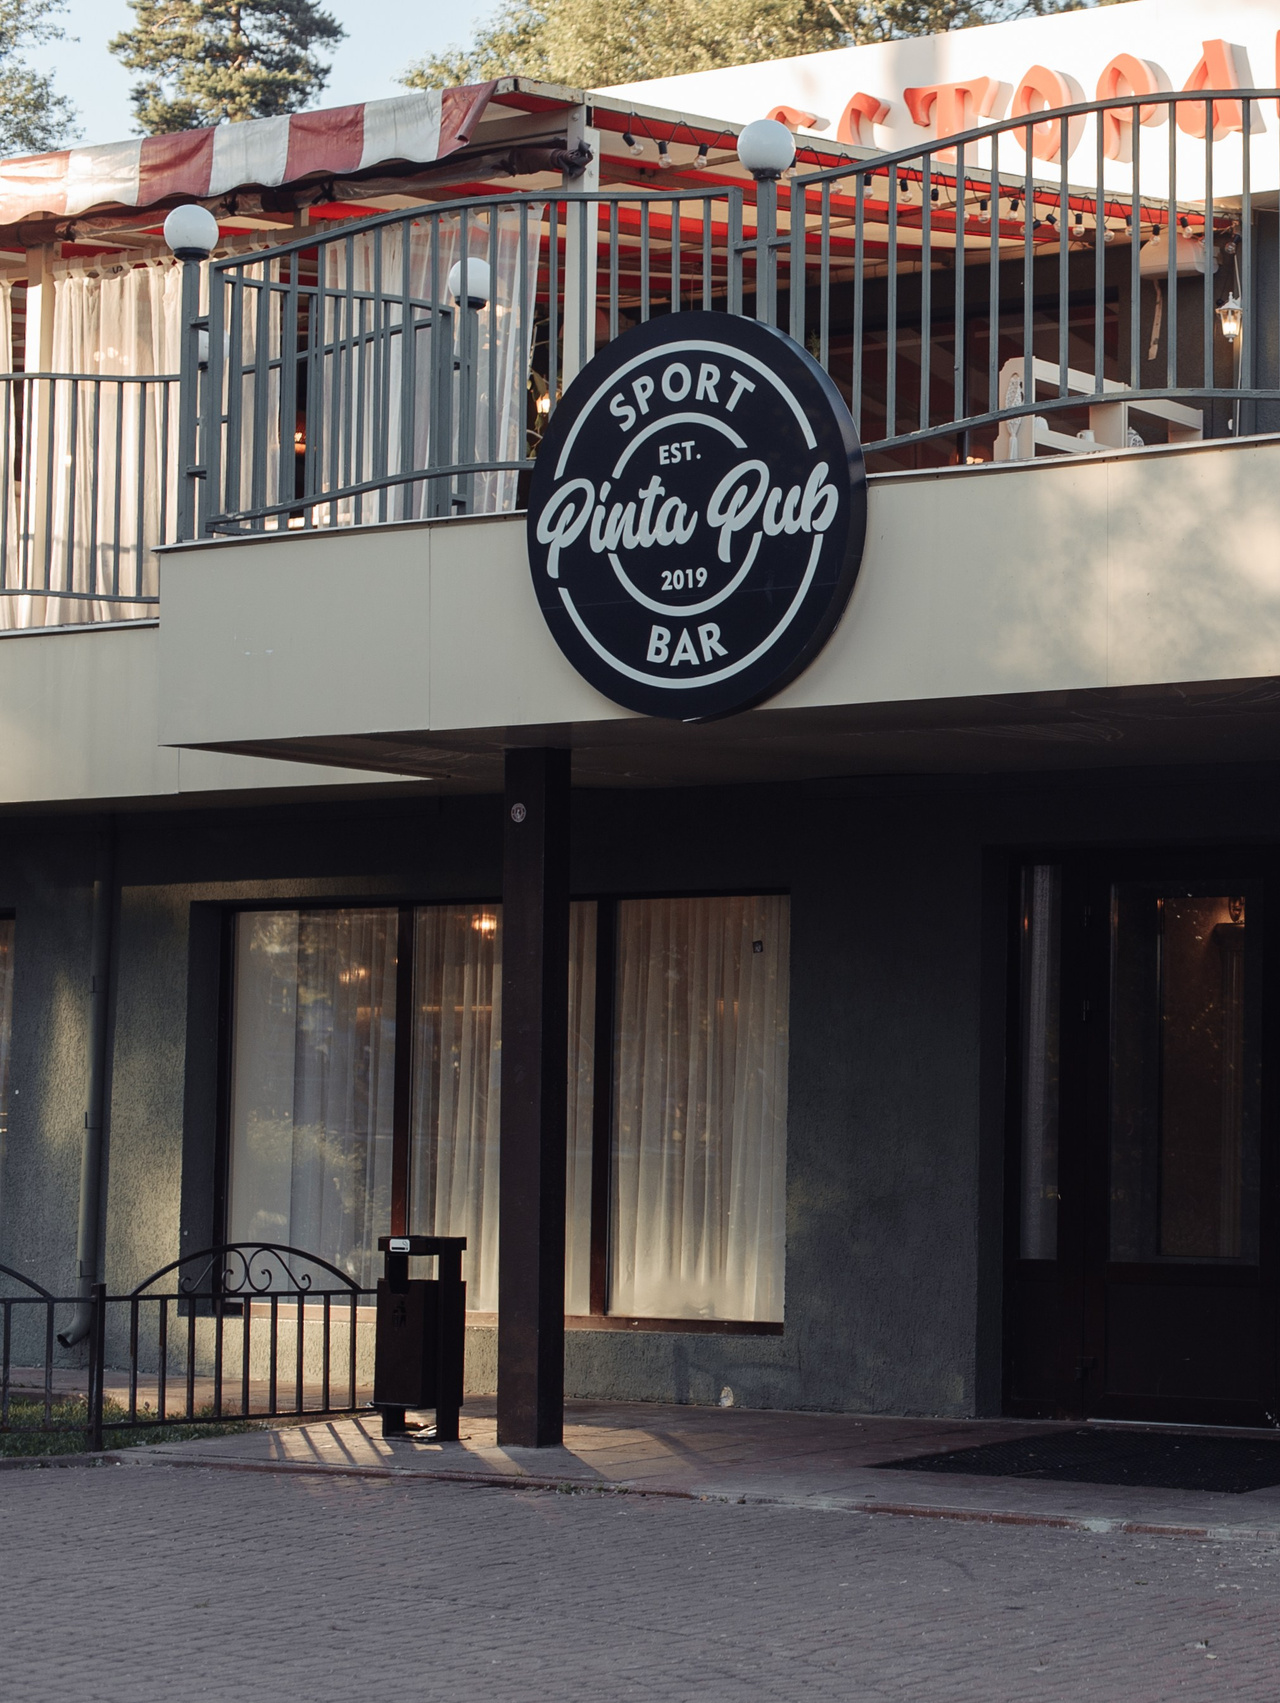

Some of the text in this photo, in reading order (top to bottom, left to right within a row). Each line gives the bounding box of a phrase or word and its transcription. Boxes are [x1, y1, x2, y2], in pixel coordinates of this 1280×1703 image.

[609, 363, 756, 432] SPORT
[659, 440, 702, 465] EST.
[536, 459, 839, 579] Pinta Pub
[661, 567, 708, 591] 2019
[646, 622, 728, 666] BAR
